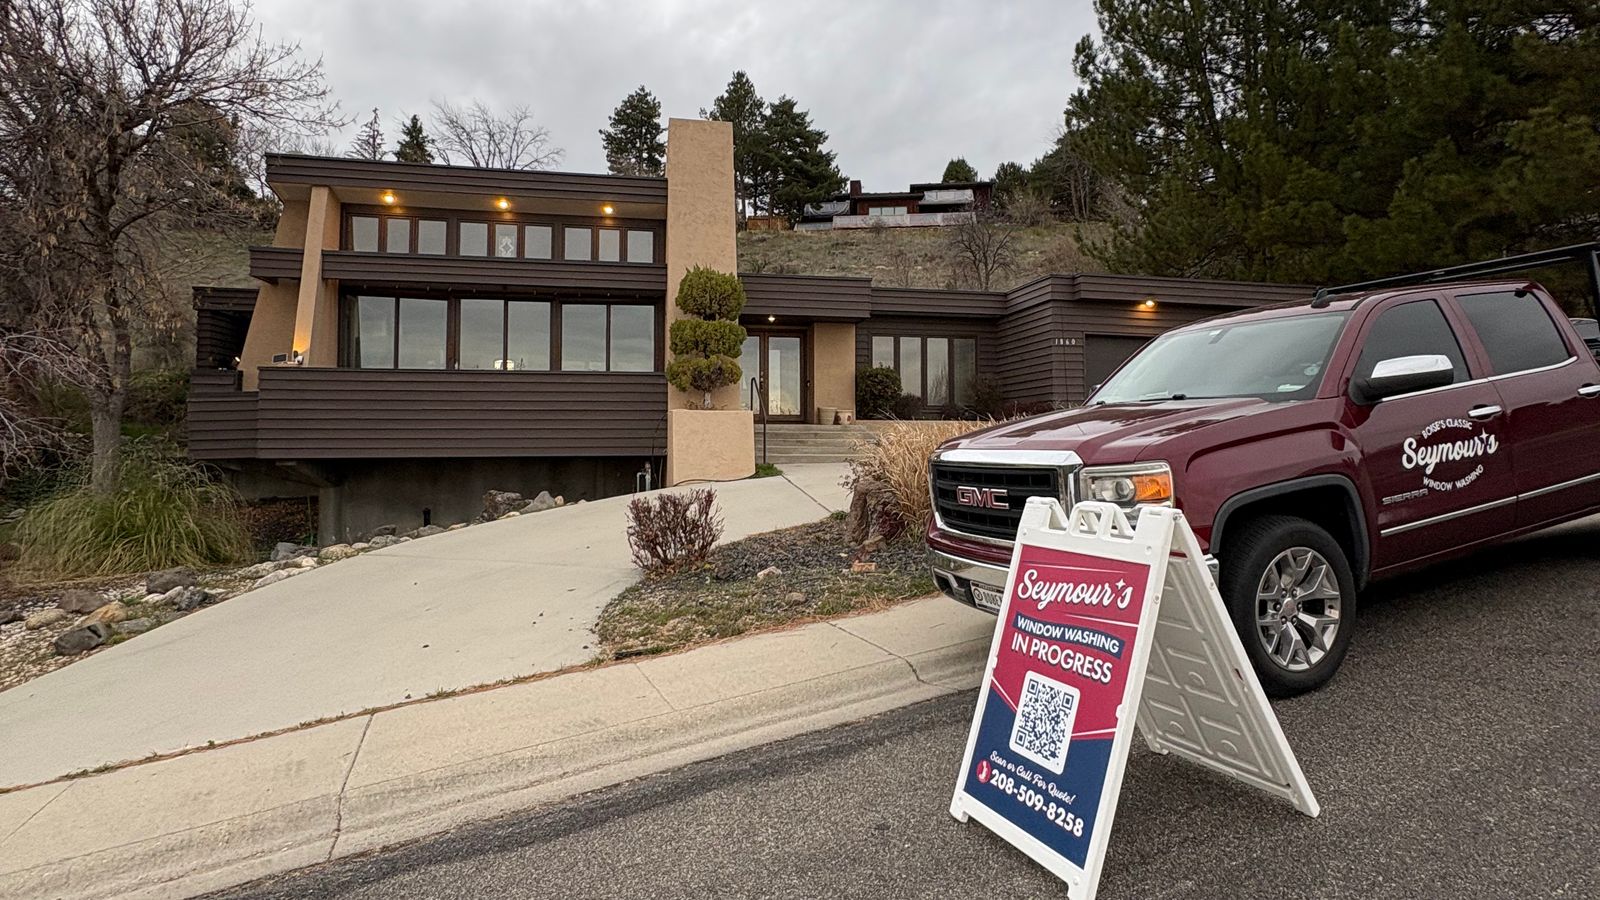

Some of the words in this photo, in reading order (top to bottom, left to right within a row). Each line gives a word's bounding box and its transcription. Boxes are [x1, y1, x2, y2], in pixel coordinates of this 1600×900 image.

[1422, 419, 1446, 439] BOISE'S
[1446, 418, 1473, 430] CLASSIC
[1402, 428, 1499, 475] Seymour's
[957, 485, 1009, 510] GMC
[1382, 488, 1428, 505] SIERRA
[1423, 476, 1453, 491] WINDOW
[1455, 464, 1484, 489] WASHING
[1017, 569, 1133, 610] Seymour's
[1017, 615, 1064, 639] WINDOW
[1064, 627, 1119, 654] WASHING
[1011, 632, 1029, 654] IN
[1030, 638, 1113, 683] PROGRESS
[990, 750, 1007, 768] Scan
[1007, 763, 1016, 772] or
[1016, 765, 1033, 781] Call
[1032, 773, 1047, 790] For
[1048, 782, 1076, 805] Quote!
[990, 769, 1084, 837] 208-509-8258
